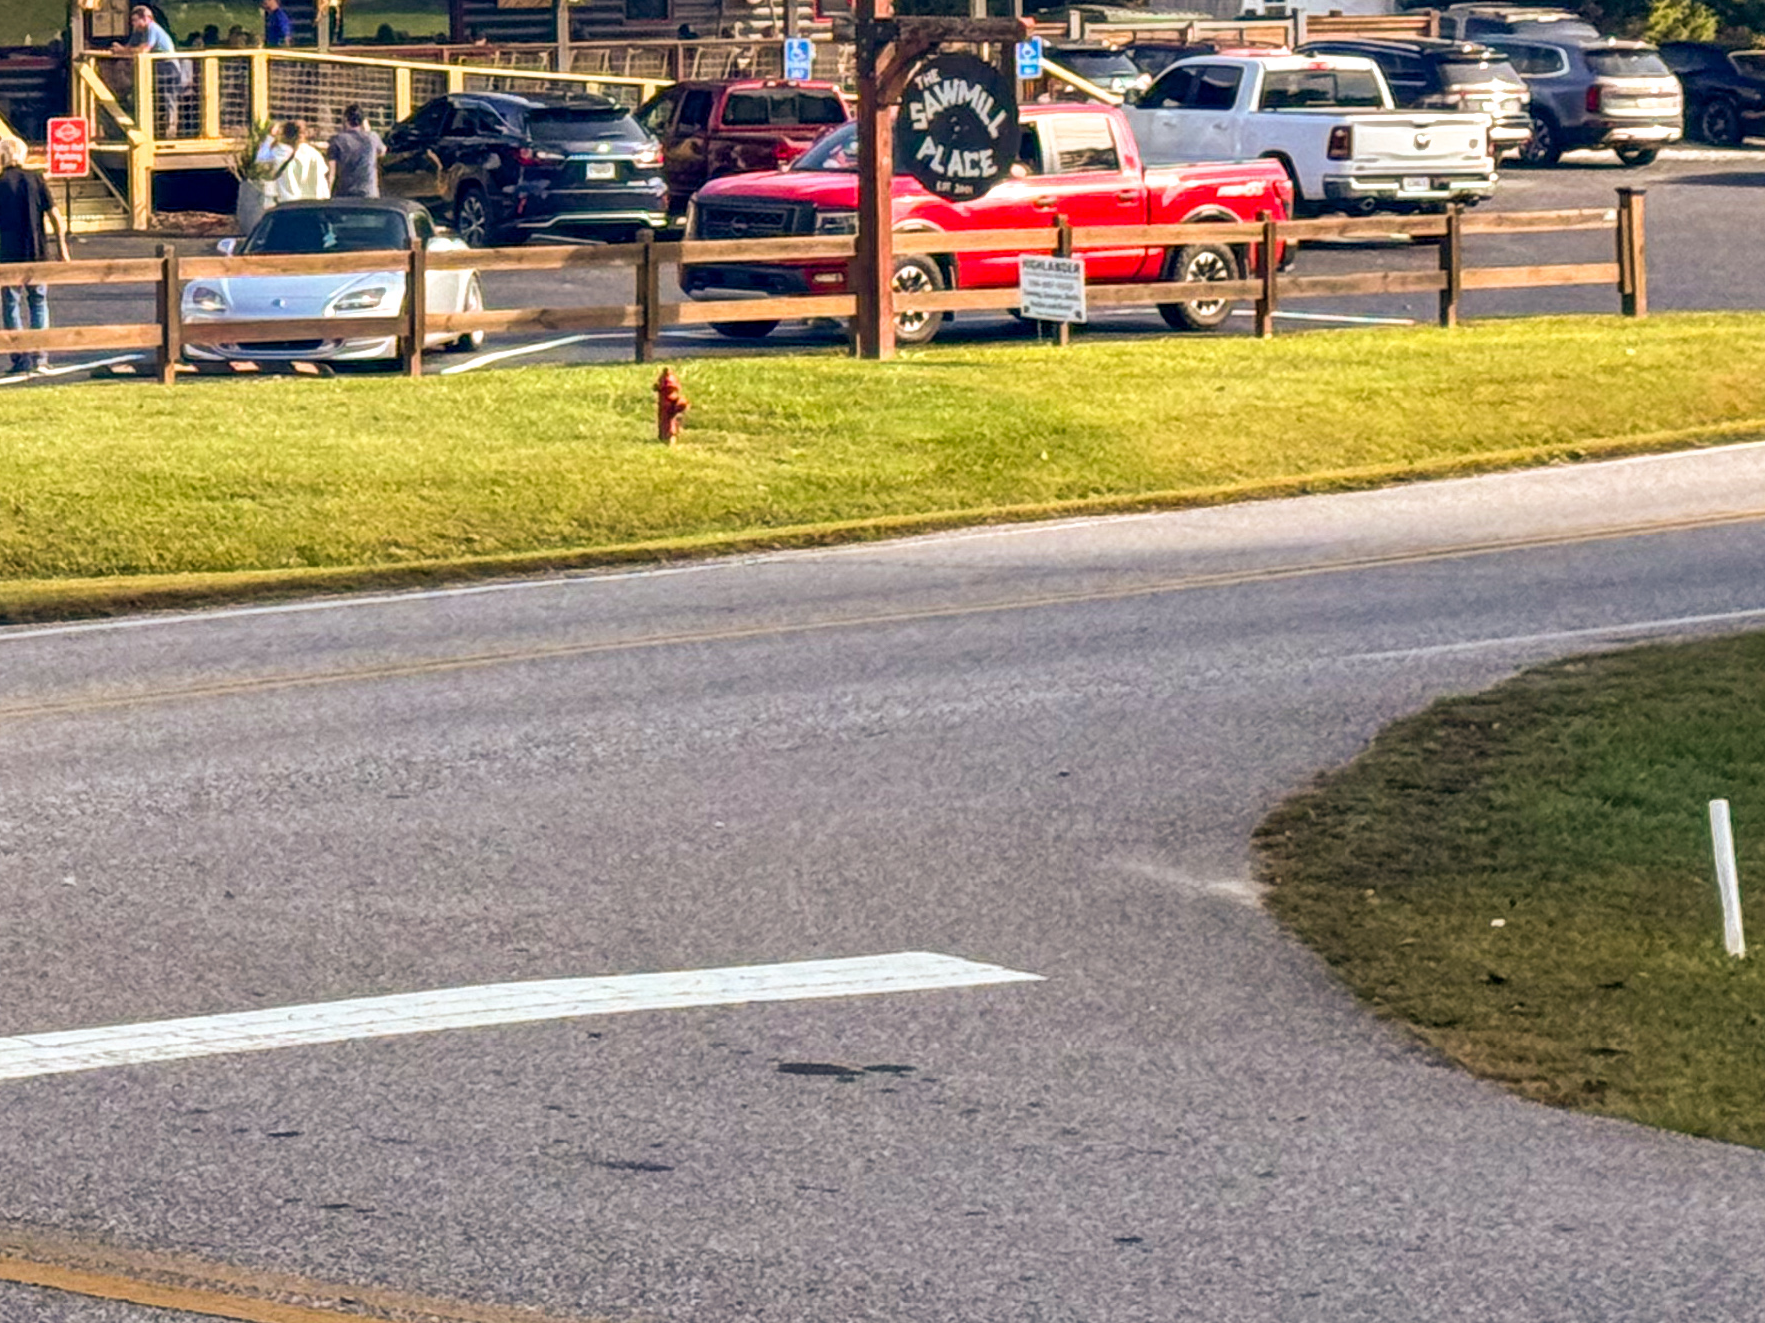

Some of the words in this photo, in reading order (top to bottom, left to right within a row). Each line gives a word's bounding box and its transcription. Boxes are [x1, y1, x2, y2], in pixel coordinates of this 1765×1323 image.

[914, 68, 942, 91] THE
[909, 78, 1007, 139] SAWMILL
[916, 136, 998, 178] PLACE
